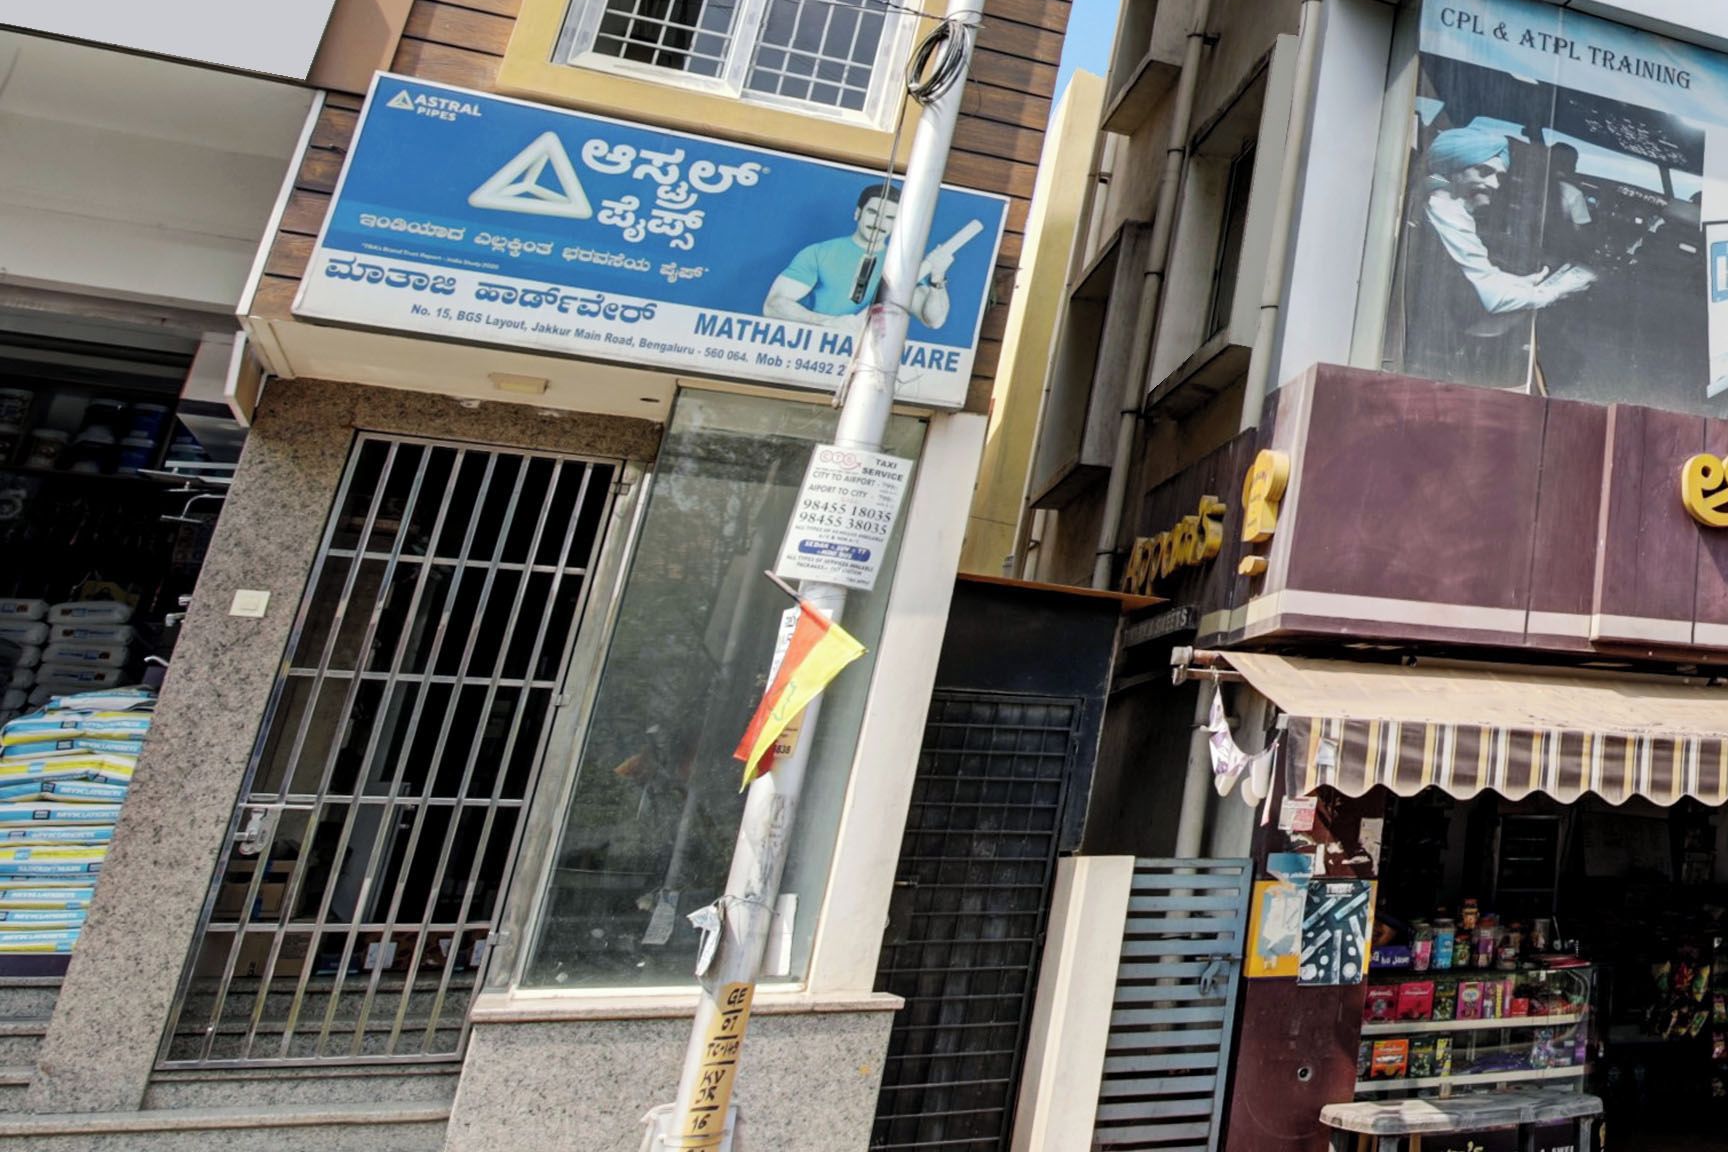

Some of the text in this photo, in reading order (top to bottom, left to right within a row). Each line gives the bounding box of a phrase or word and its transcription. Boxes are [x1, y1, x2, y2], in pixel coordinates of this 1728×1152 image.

[1440, 8, 1691, 89] CPL & ATPL TRAINING
[414, 94, 482, 117] ASTRAL
[416, 106, 457, 122] PIPES
[582, 139, 762, 209] ಆಸ್ಟ್ರಲ್
[597, 195, 705, 250] ಪೈಪ್ಸ್
[411, 304, 431, 317] No.
[436, 308, 452, 320] 15,
[457, 311, 482, 324] BGS
[485, 314, 528, 332] Layout,
[531, 321, 571, 337] Jakkur
[574, 328, 602, 341] Main
[604, 332, 635, 349] Road,
[638, 338, 694, 355] Bengaluru
[704, 347, 724, 359] 560
[726, 350, 749, 363] 064.
[755, 352, 783, 368] Mob
[794, 359, 833, 376] 94492
[694, 312, 812, 351] MATHAJI
[813, 471, 830, 479] CITY
[832, 473, 842, 481] TO
[862, 468, 903, 481] SERVICE
[876, 458, 897, 469] TAXI
[803, 498, 892, 523] 98455 18035
[800, 511, 887, 536] 98455 38035
[727, 987, 748, 1006] GE
